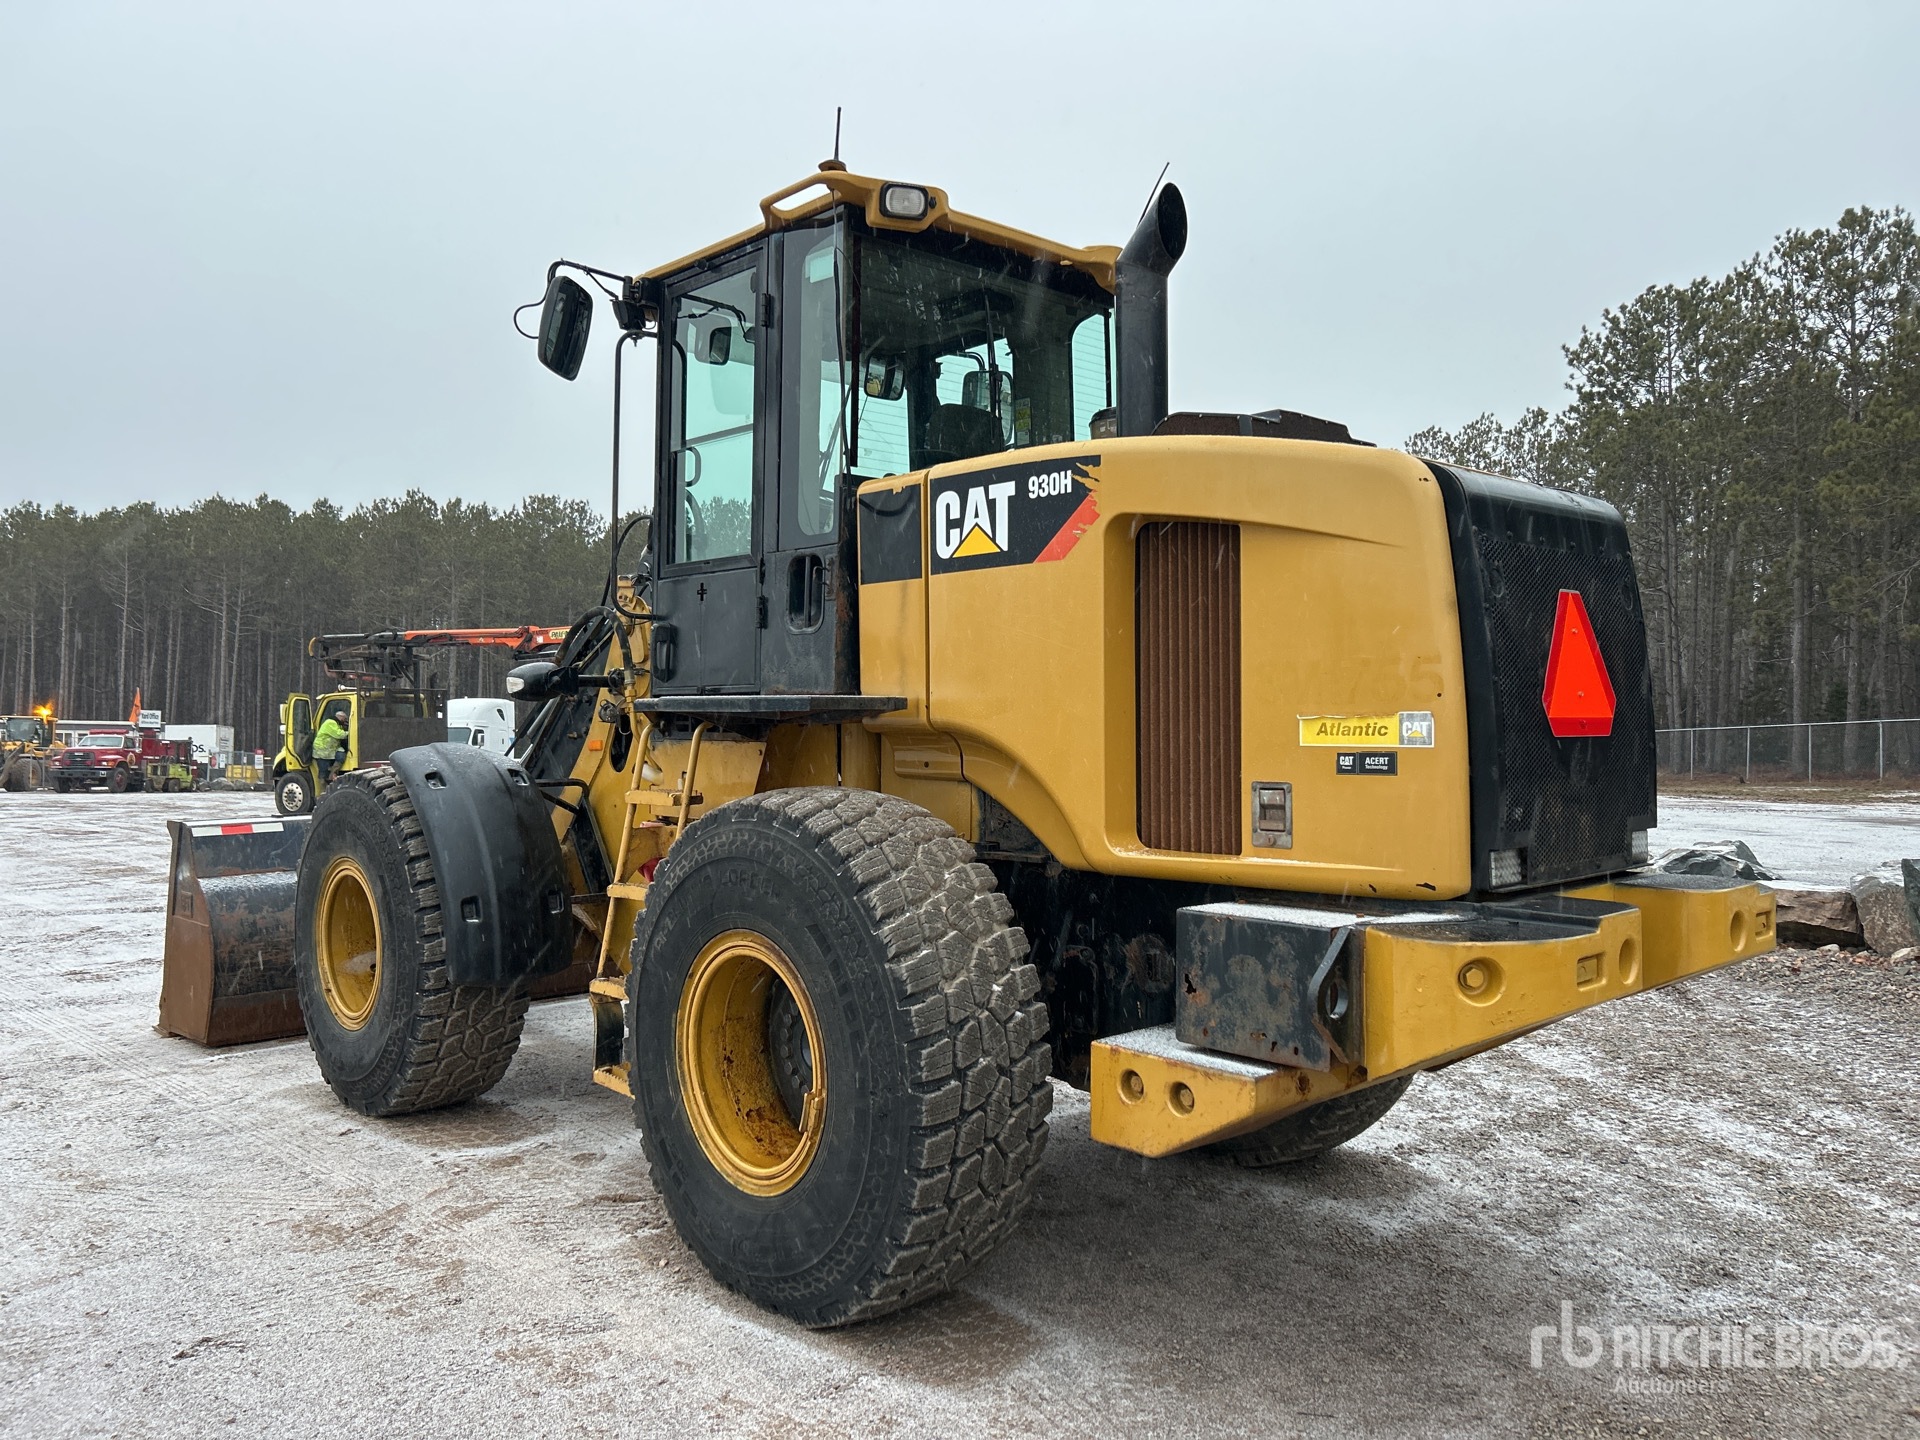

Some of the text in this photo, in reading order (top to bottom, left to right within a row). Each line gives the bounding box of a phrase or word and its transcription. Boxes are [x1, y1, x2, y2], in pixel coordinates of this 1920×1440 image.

[1028, 470, 1072, 499] 930H
[936, 480, 1016, 560] CAT
[1316, 721, 1431, 738] Atlantic CAT
[1339, 756, 1354, 766] CAT
[1364, 757, 1389, 765] ACERT
